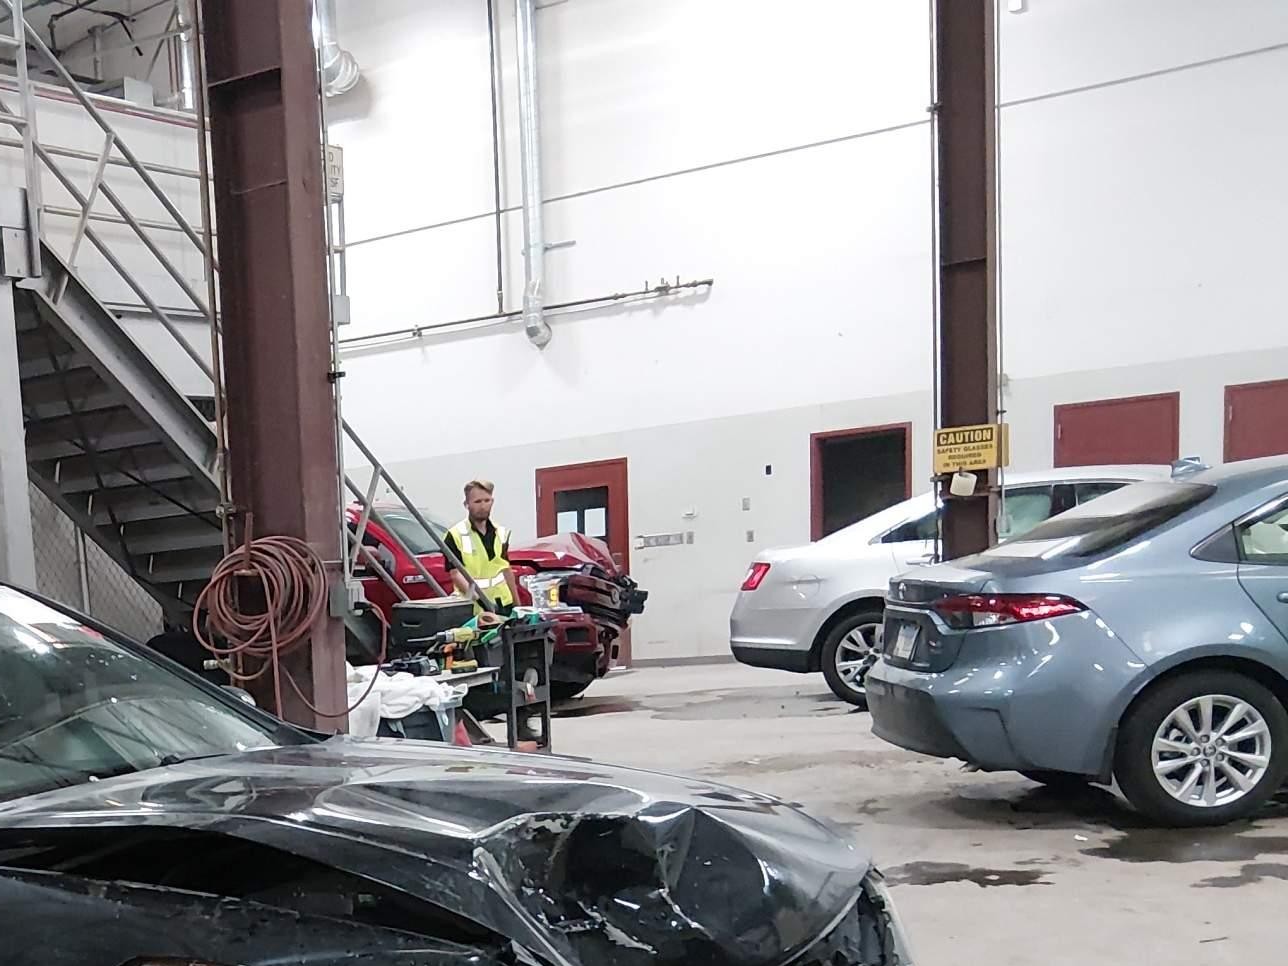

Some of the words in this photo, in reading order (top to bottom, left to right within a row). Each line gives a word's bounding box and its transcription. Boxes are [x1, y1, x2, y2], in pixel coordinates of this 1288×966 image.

[939, 429, 992, 445] CAUTION
[937, 447, 961, 455] SAFETY
[963, 444, 993, 452] GLASSES
[948, 452, 982, 460] REQUIRED
